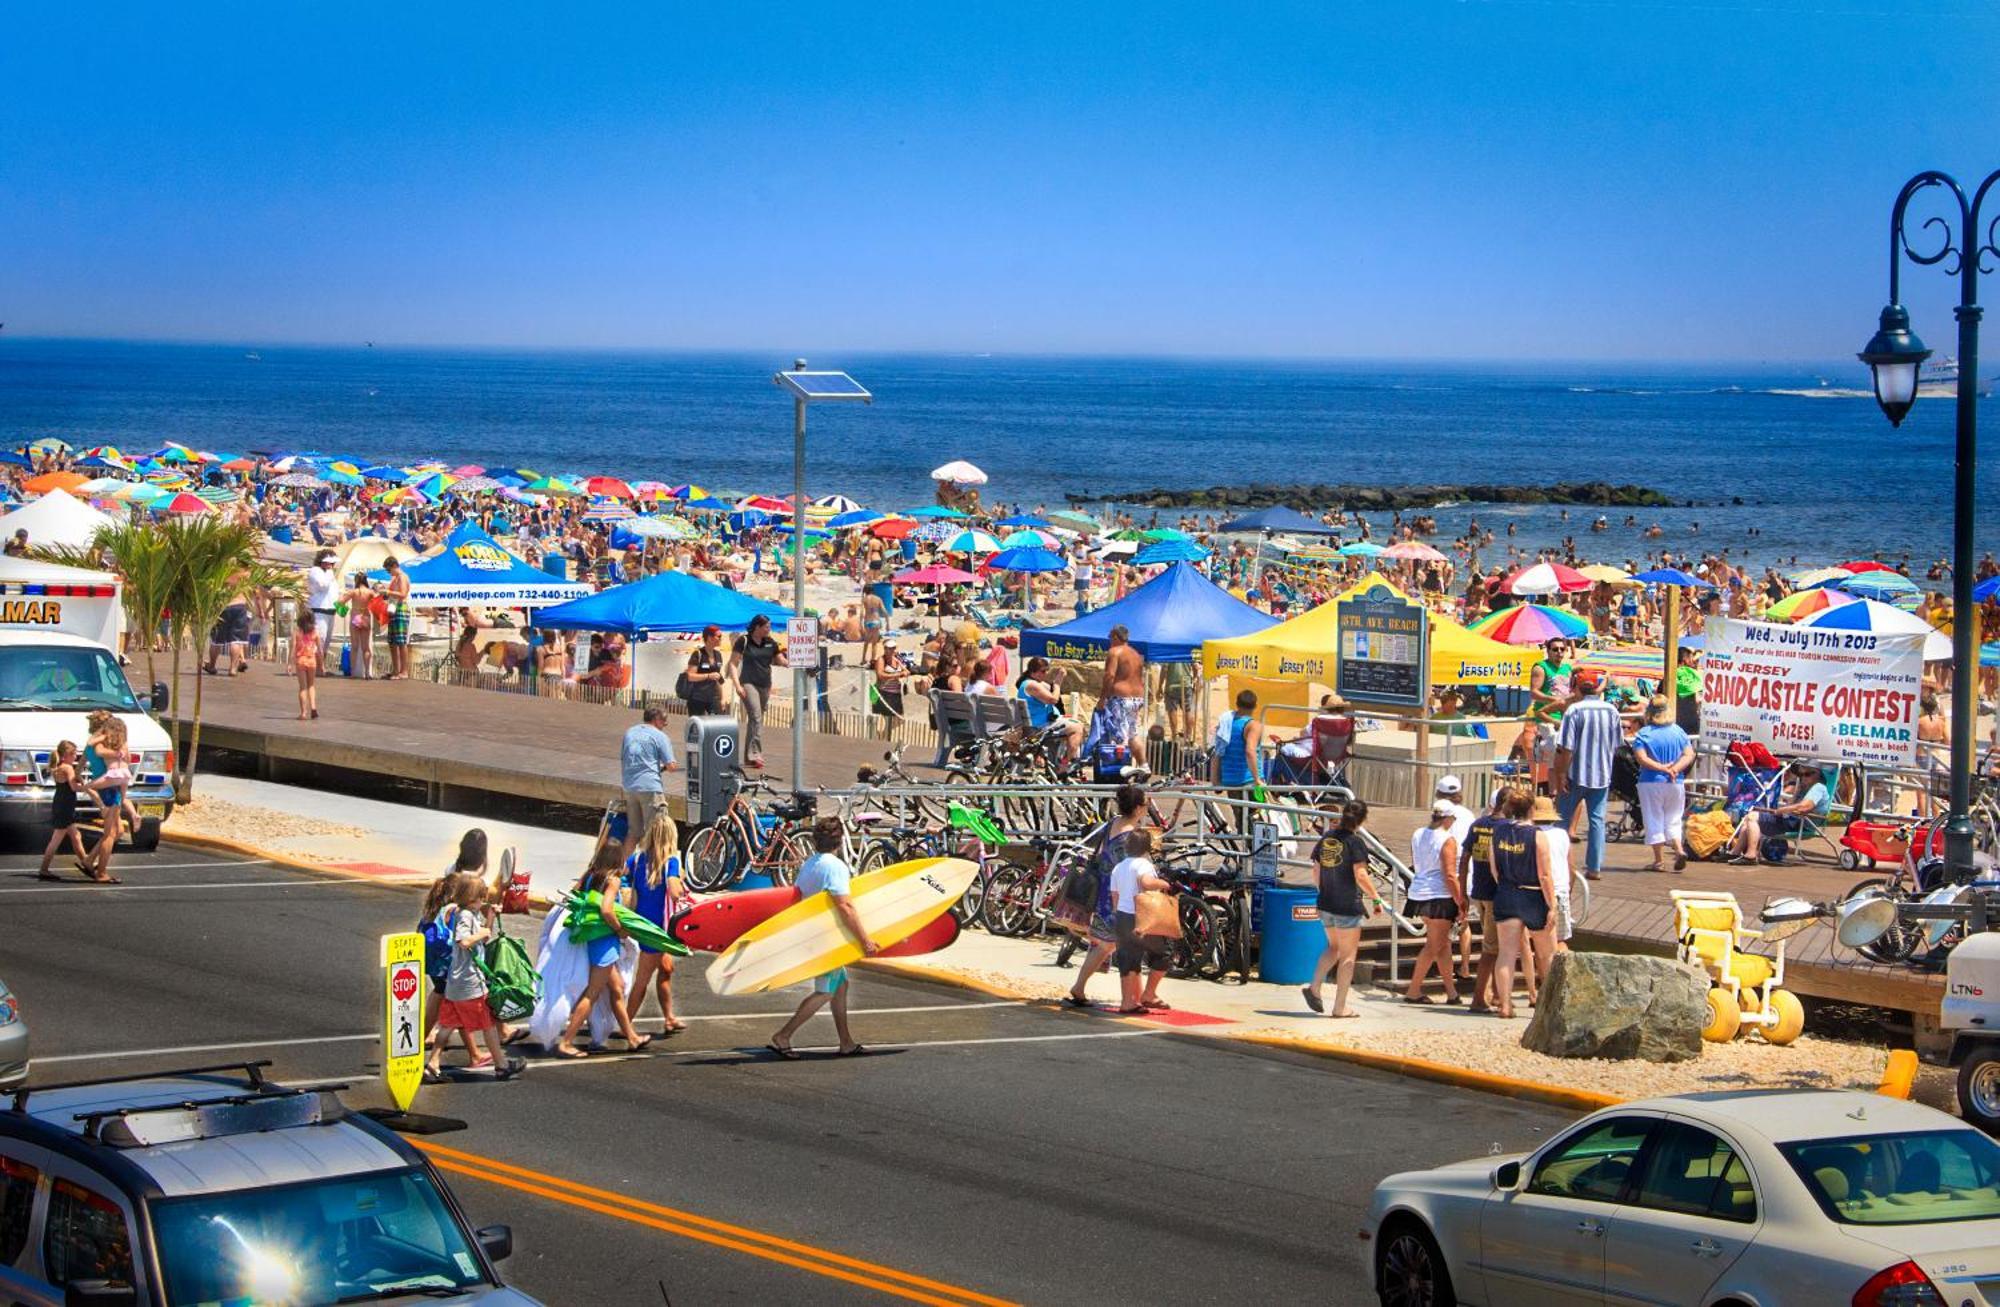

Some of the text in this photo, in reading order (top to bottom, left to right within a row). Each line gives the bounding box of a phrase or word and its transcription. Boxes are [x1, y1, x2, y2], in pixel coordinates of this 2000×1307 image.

[410, 590, 516, 600] www.worldjeep.com
[0, 601, 61, 624] MAR
[796, 623, 807, 632] NO
[1388, 618, 1418, 631] BEACH
[789, 636, 816, 645] PARKING
[1746, 627, 1878, 650] Wed. July 17th 2013
[1216, 653, 1259, 670] JERSEY 101.5
[1799, 652, 1821, 661] TOURISM
[1279, 657, 1324, 675] JERSEY 101.5
[1458, 661, 1521, 678] JERSEY 101.5
[1706, 659, 1791, 677] NEW JERSEY
[1704, 672, 1916, 723] SANDCASTLE CONTEST
[1839, 724, 1911, 742] BELMAR
[719, 738, 730, 754] P
[1888, 743, 1909, 752] beach
[394, 937, 417, 949] STATE
[396, 950, 414, 960] LAW
[393, 978, 416, 993] STOP
